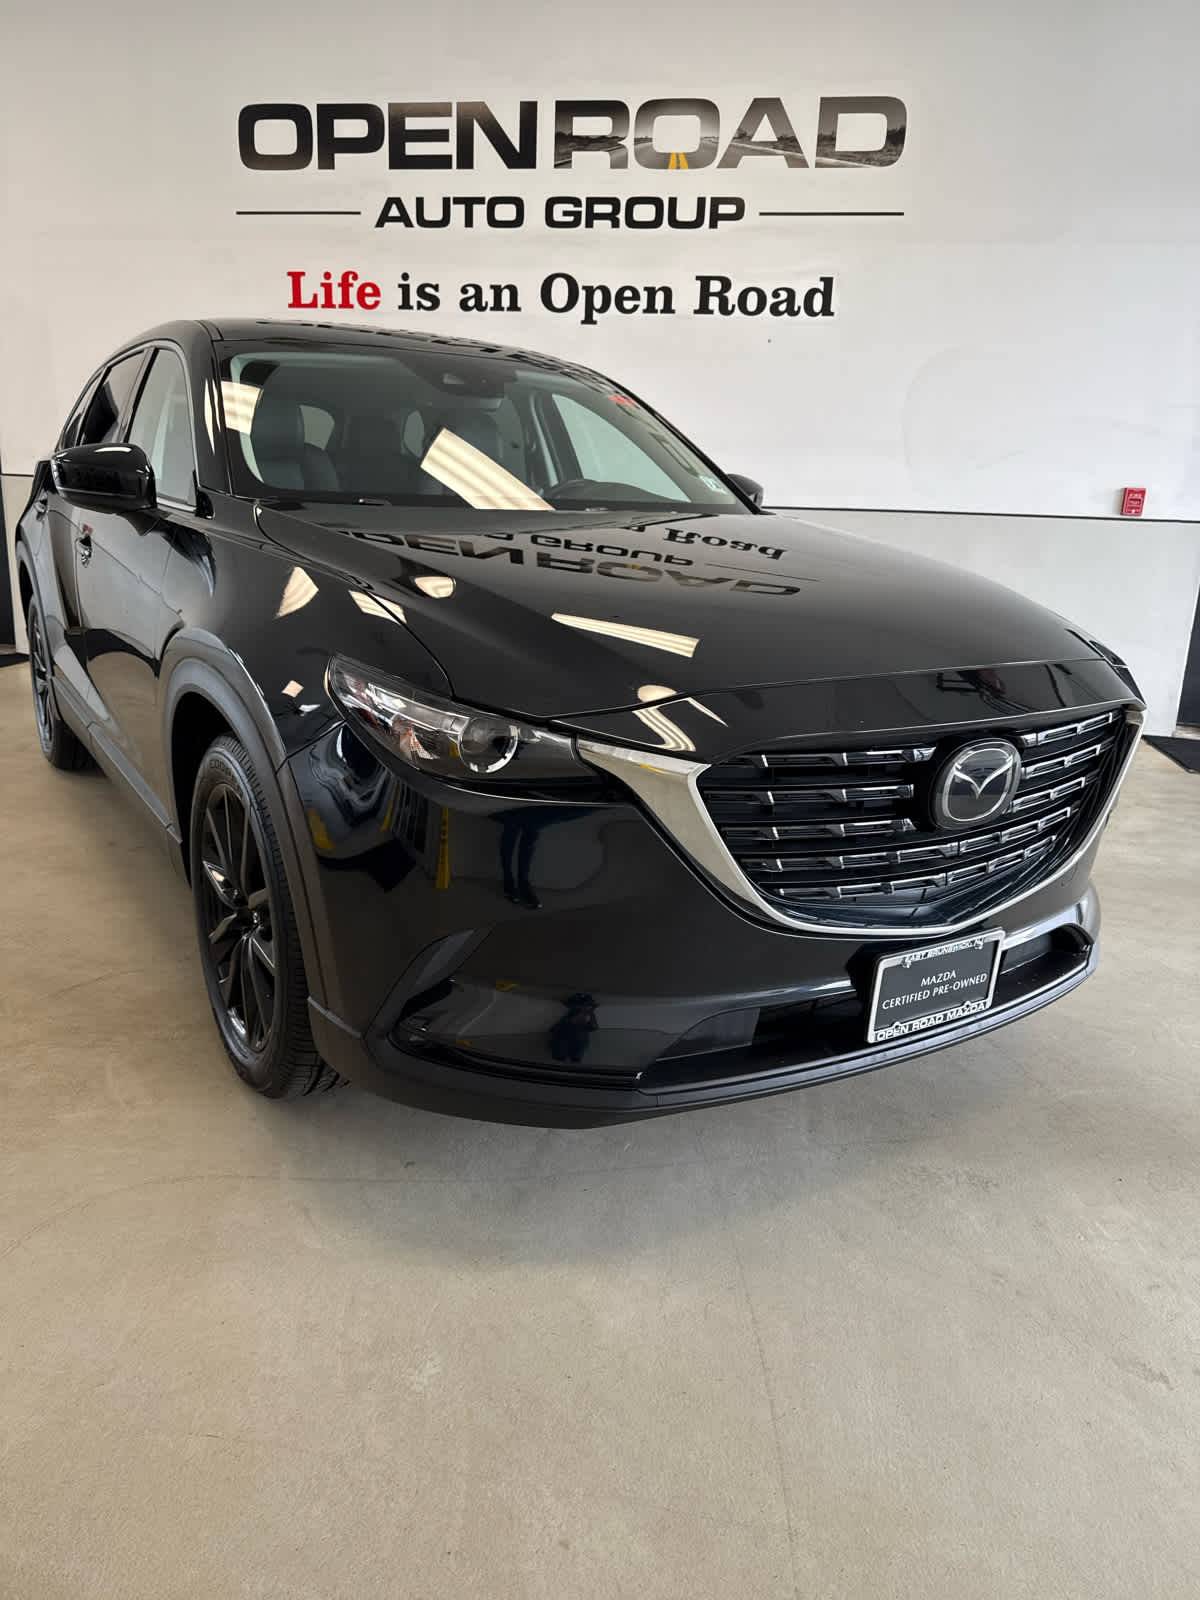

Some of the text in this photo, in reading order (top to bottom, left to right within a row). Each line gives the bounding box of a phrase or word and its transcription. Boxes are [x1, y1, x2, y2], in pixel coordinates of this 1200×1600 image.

[238, 96, 907, 170] OPEN ROAD
[375, 196, 745, 229] AUTO GROUP
[287, 271, 835, 325] Life is an Open Road
[882, 973, 988, 1010] CERTIFIED PRE-OWNED
[920, 970, 957, 987] MAZDA
[876, 1002, 985, 1041] OPEN ROAD MAZDA
